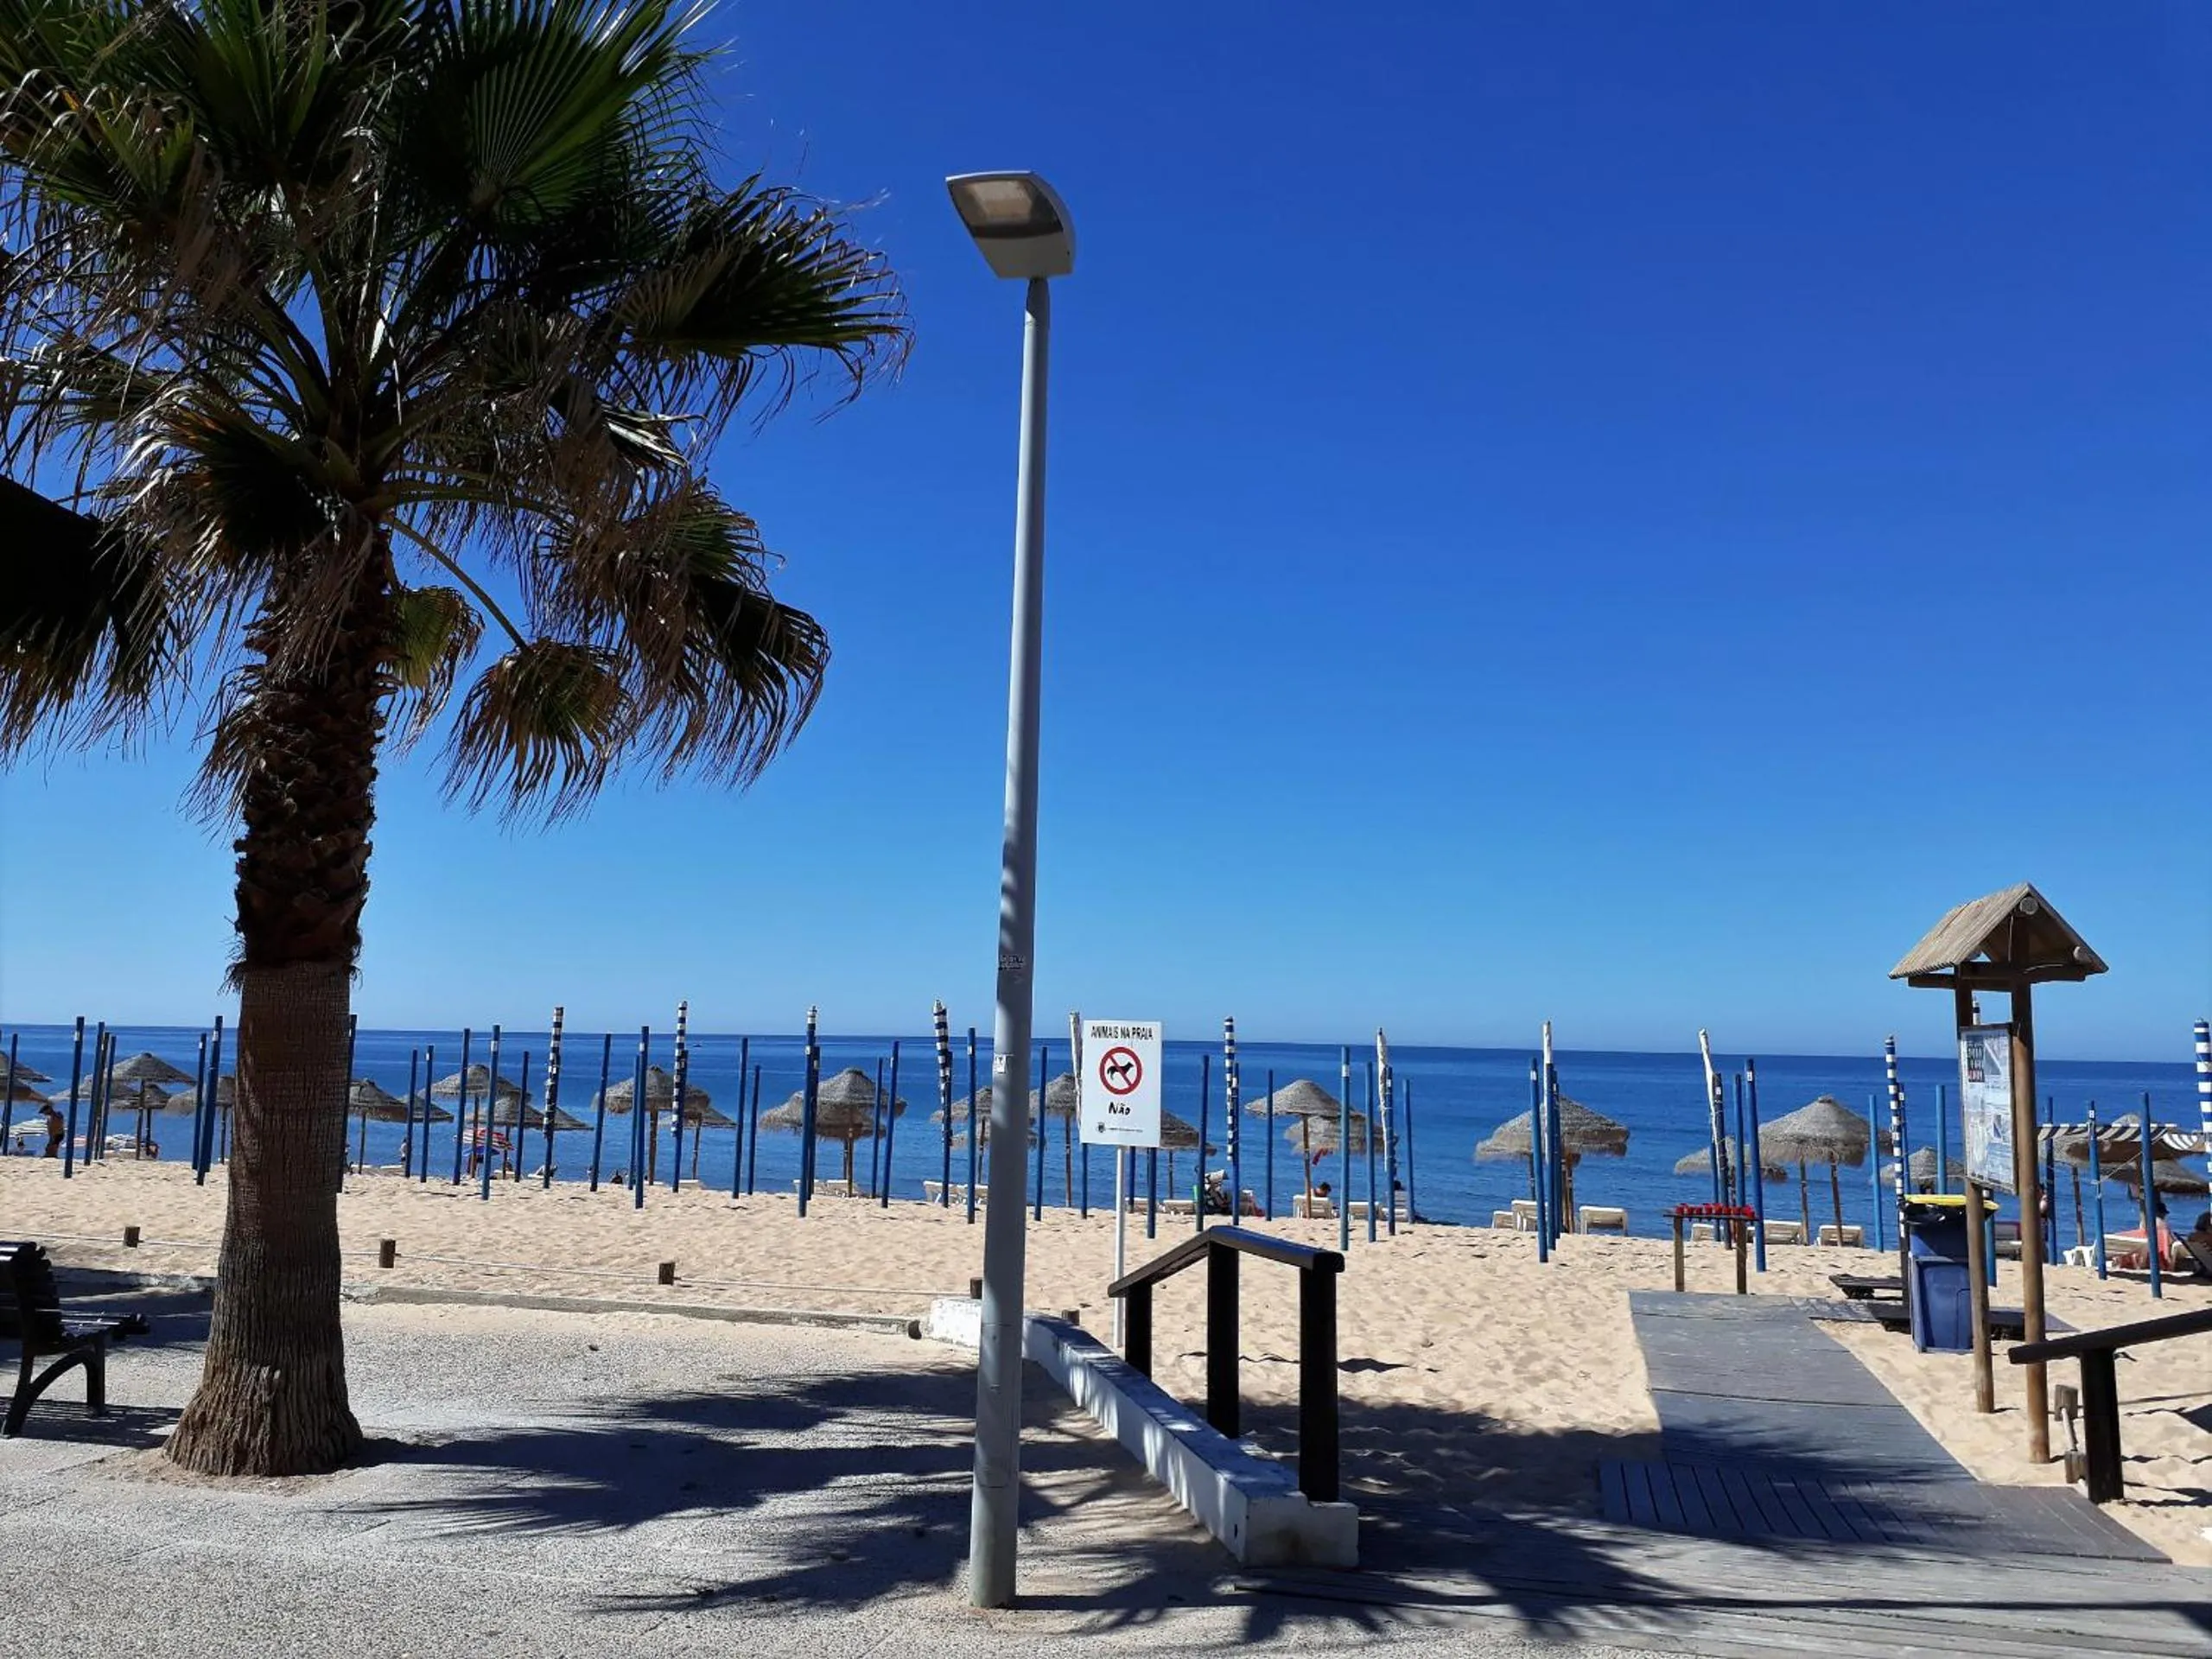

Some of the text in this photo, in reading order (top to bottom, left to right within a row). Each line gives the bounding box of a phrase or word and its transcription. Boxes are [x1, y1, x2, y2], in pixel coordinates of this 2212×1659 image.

[1120, 1027, 1130, 1039] NA
[1132, 1027, 1154, 1040] PRAIA
[1109, 1102, 1131, 1116] Não
